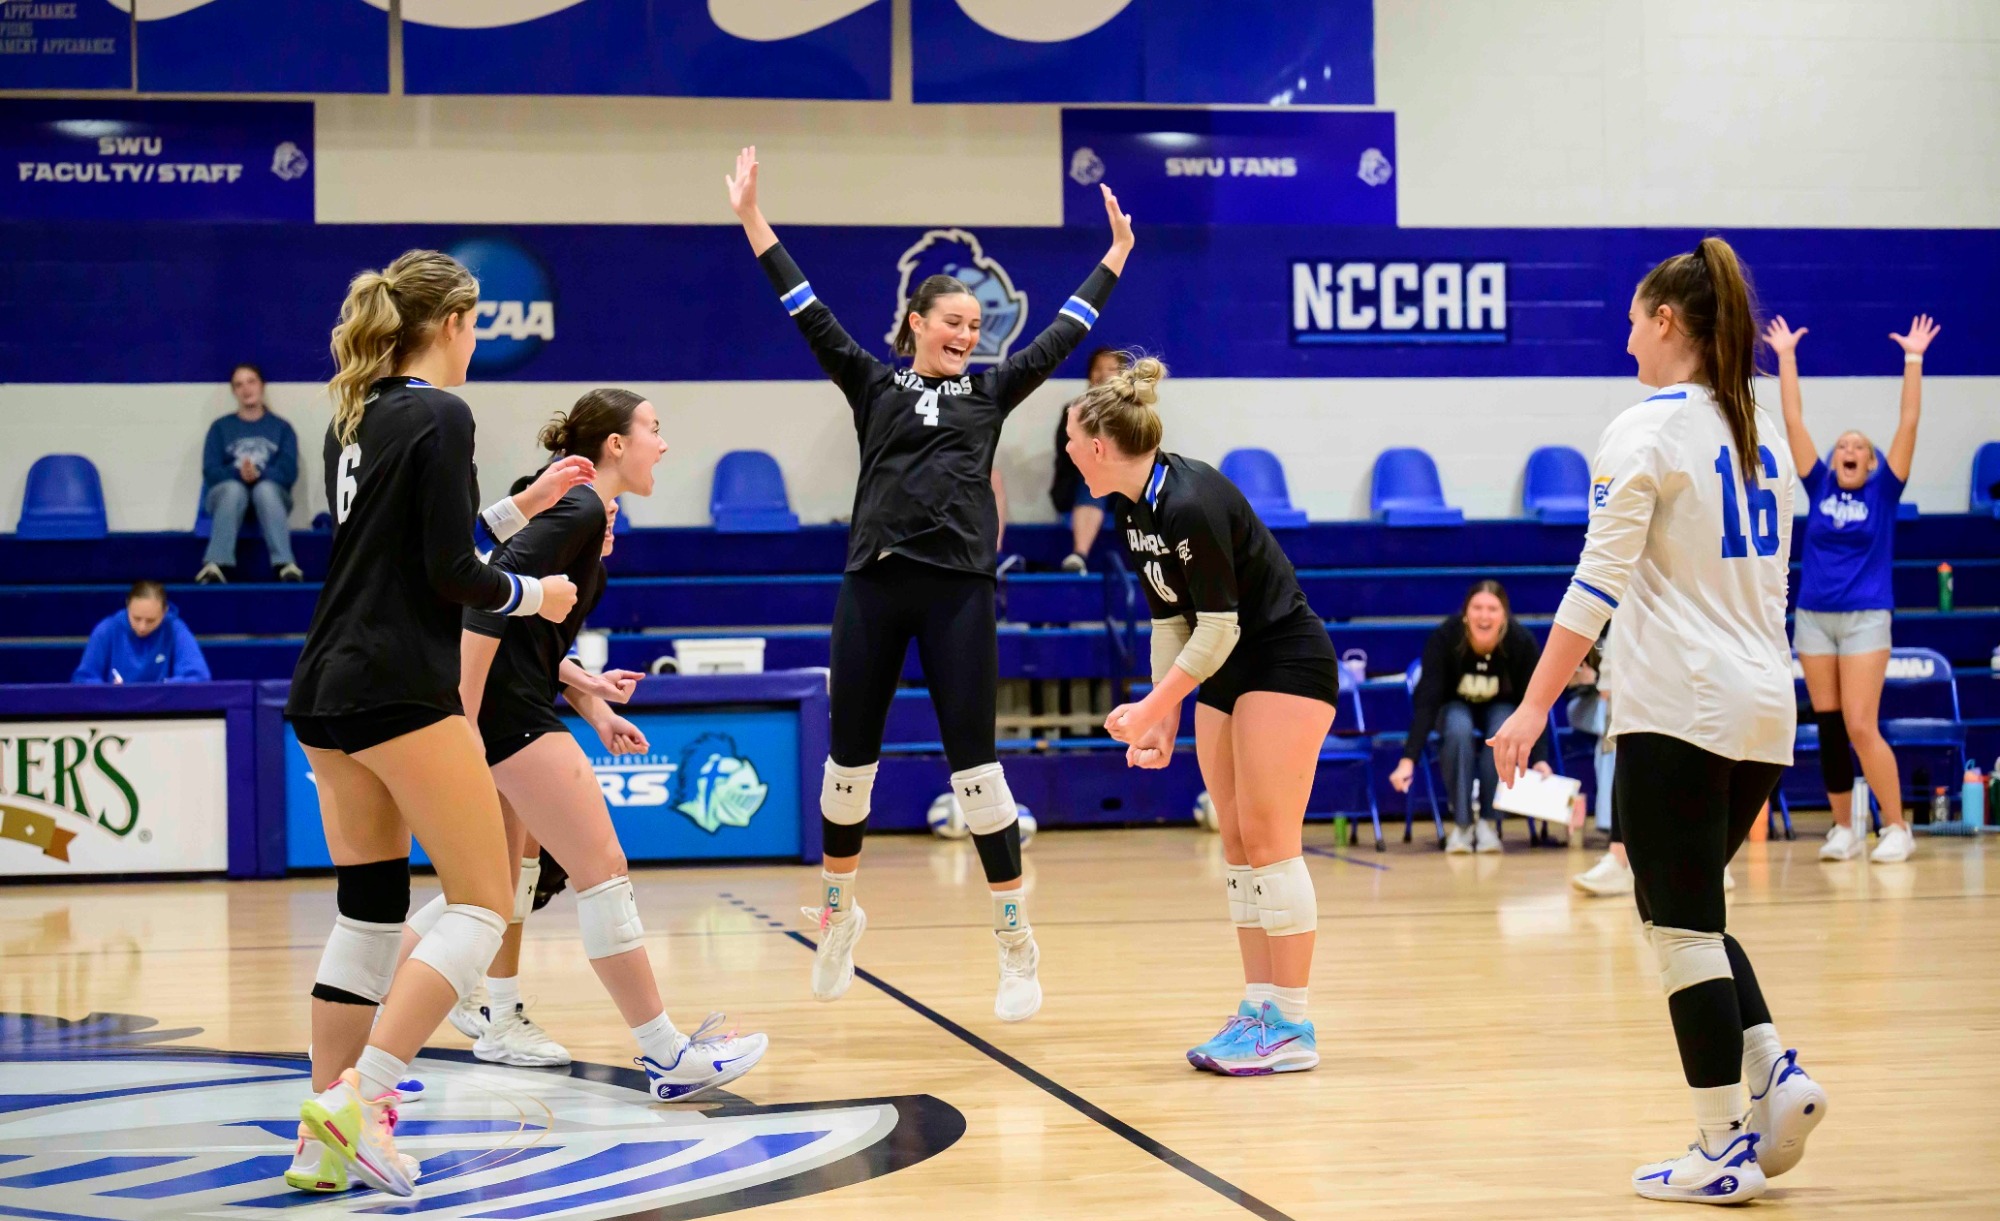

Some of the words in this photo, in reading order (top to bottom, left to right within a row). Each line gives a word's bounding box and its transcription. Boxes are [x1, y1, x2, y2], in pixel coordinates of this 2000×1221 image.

[4, 3, 77, 19] APPEARANCE
[42, 38, 115, 54] APPEARANCE
[98, 137, 162, 156] SWU
[18, 162, 243, 183] FACULTY/STAFF
[1165, 157, 1225, 177] SWU
[1229, 157, 1298, 177] FANS
[1293, 262, 1506, 330] NCCAA
[475, 301, 555, 341] CAA
[915, 389, 939, 426] 4
[337, 443, 362, 525] 6
[1715, 445, 1780, 559] 16
[1144, 561, 1178, 602] 18
[0, 728, 139, 836] ER'S
[595, 772, 670, 807] RS
